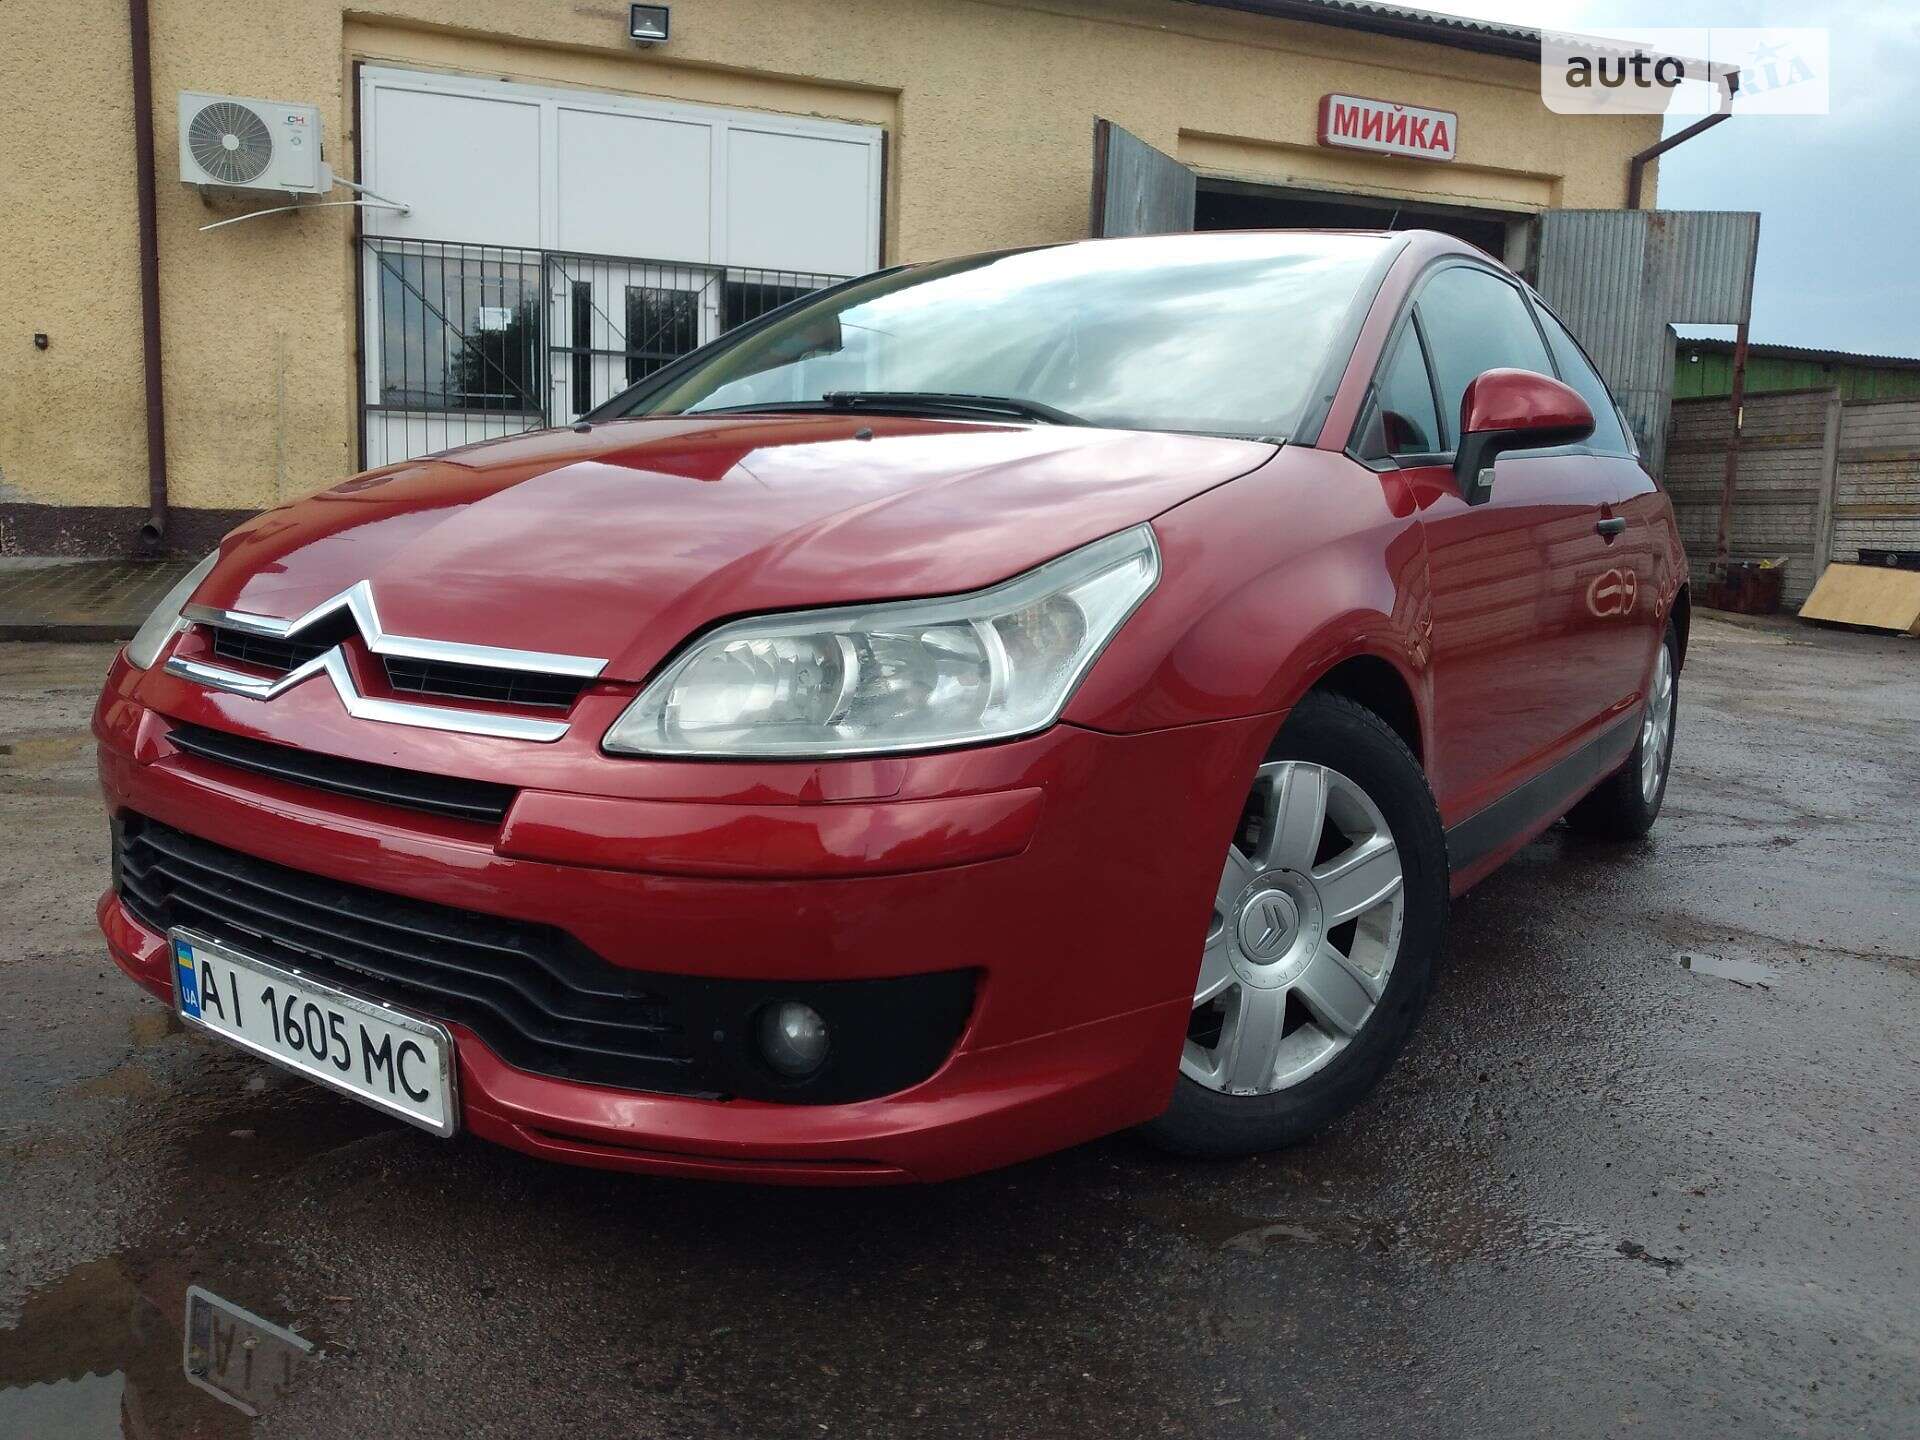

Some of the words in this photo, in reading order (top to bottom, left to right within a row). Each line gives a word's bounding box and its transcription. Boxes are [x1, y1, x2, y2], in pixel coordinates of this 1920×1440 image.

[1333, 103, 1450, 152] МИЙКА
[182, 986, 199, 1008] UA
[200, 959, 242, 1028] AI
[261, 986, 351, 1072] 1605
[359, 1023, 429, 1103] MC
